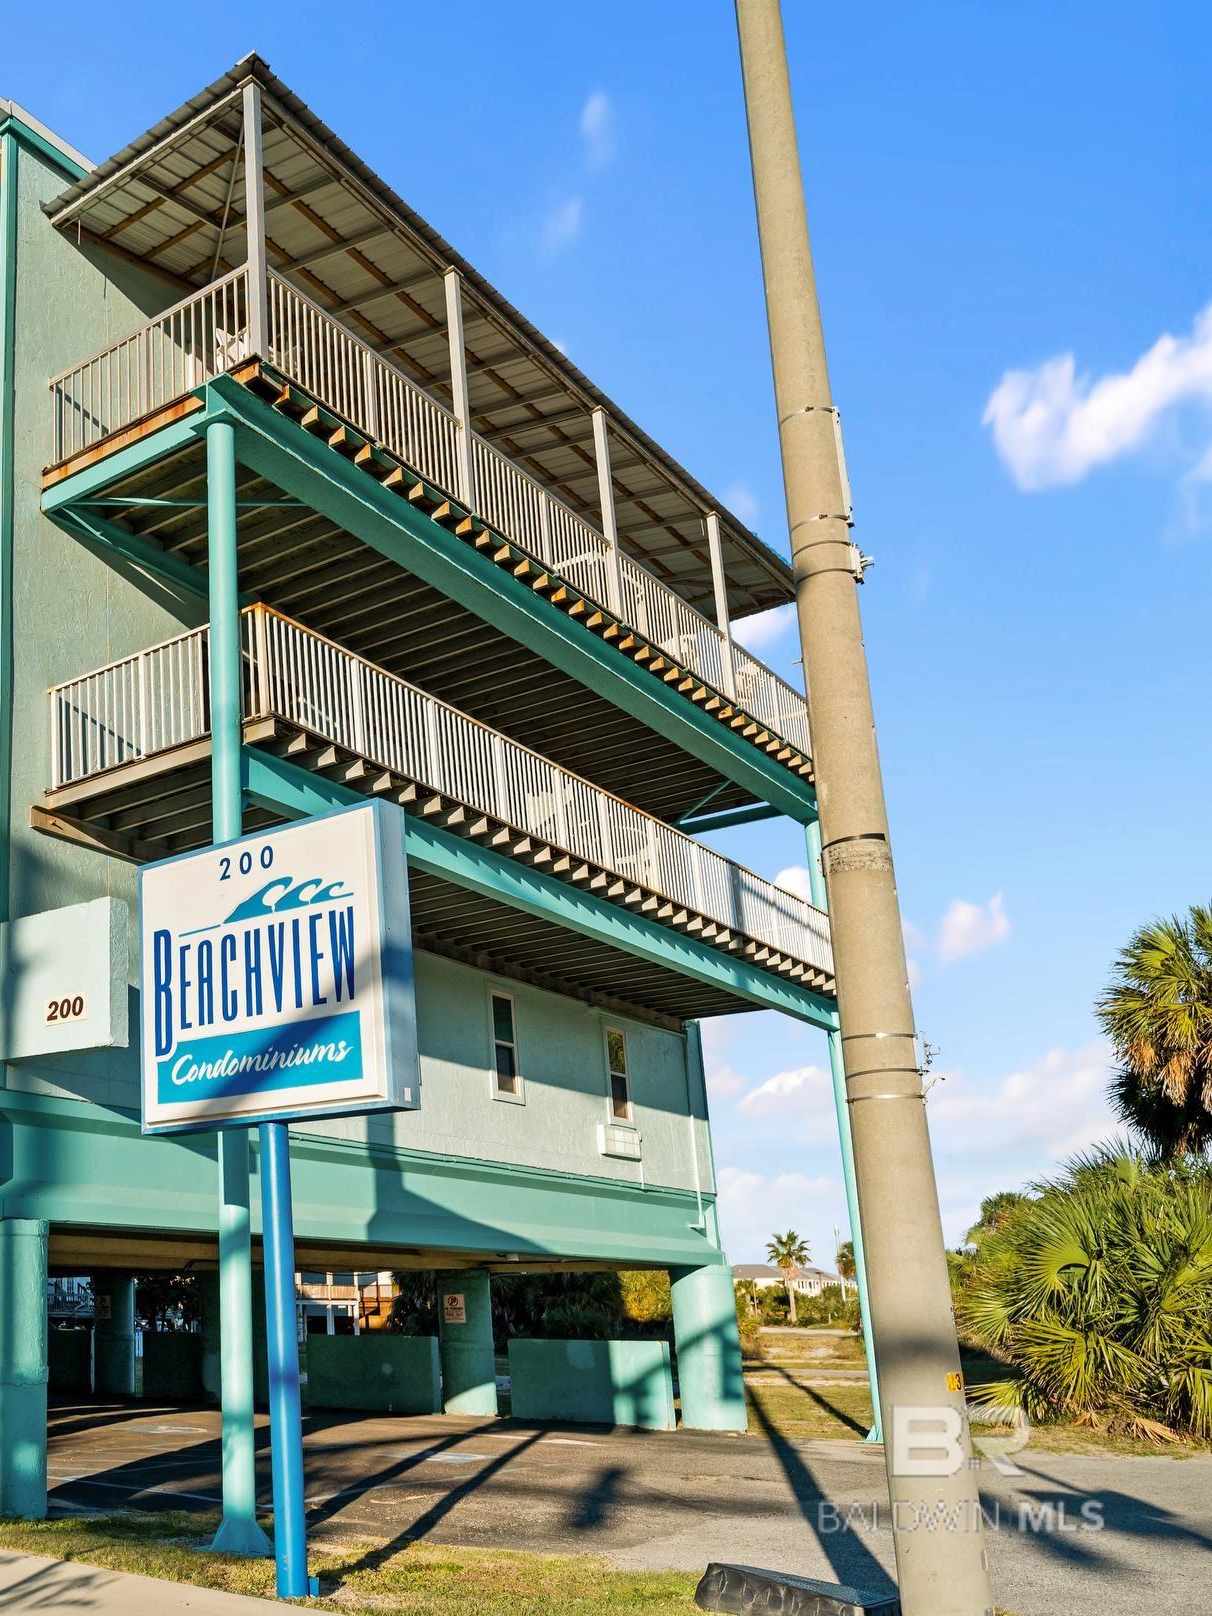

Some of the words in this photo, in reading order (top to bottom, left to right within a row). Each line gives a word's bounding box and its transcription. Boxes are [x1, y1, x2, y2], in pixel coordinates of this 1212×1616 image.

[220, 845, 274, 880] 200
[154, 906, 355, 1057] BEACHVIEW
[46, 996, 84, 1021] 200
[172, 1040, 353, 1085] Condominiums
